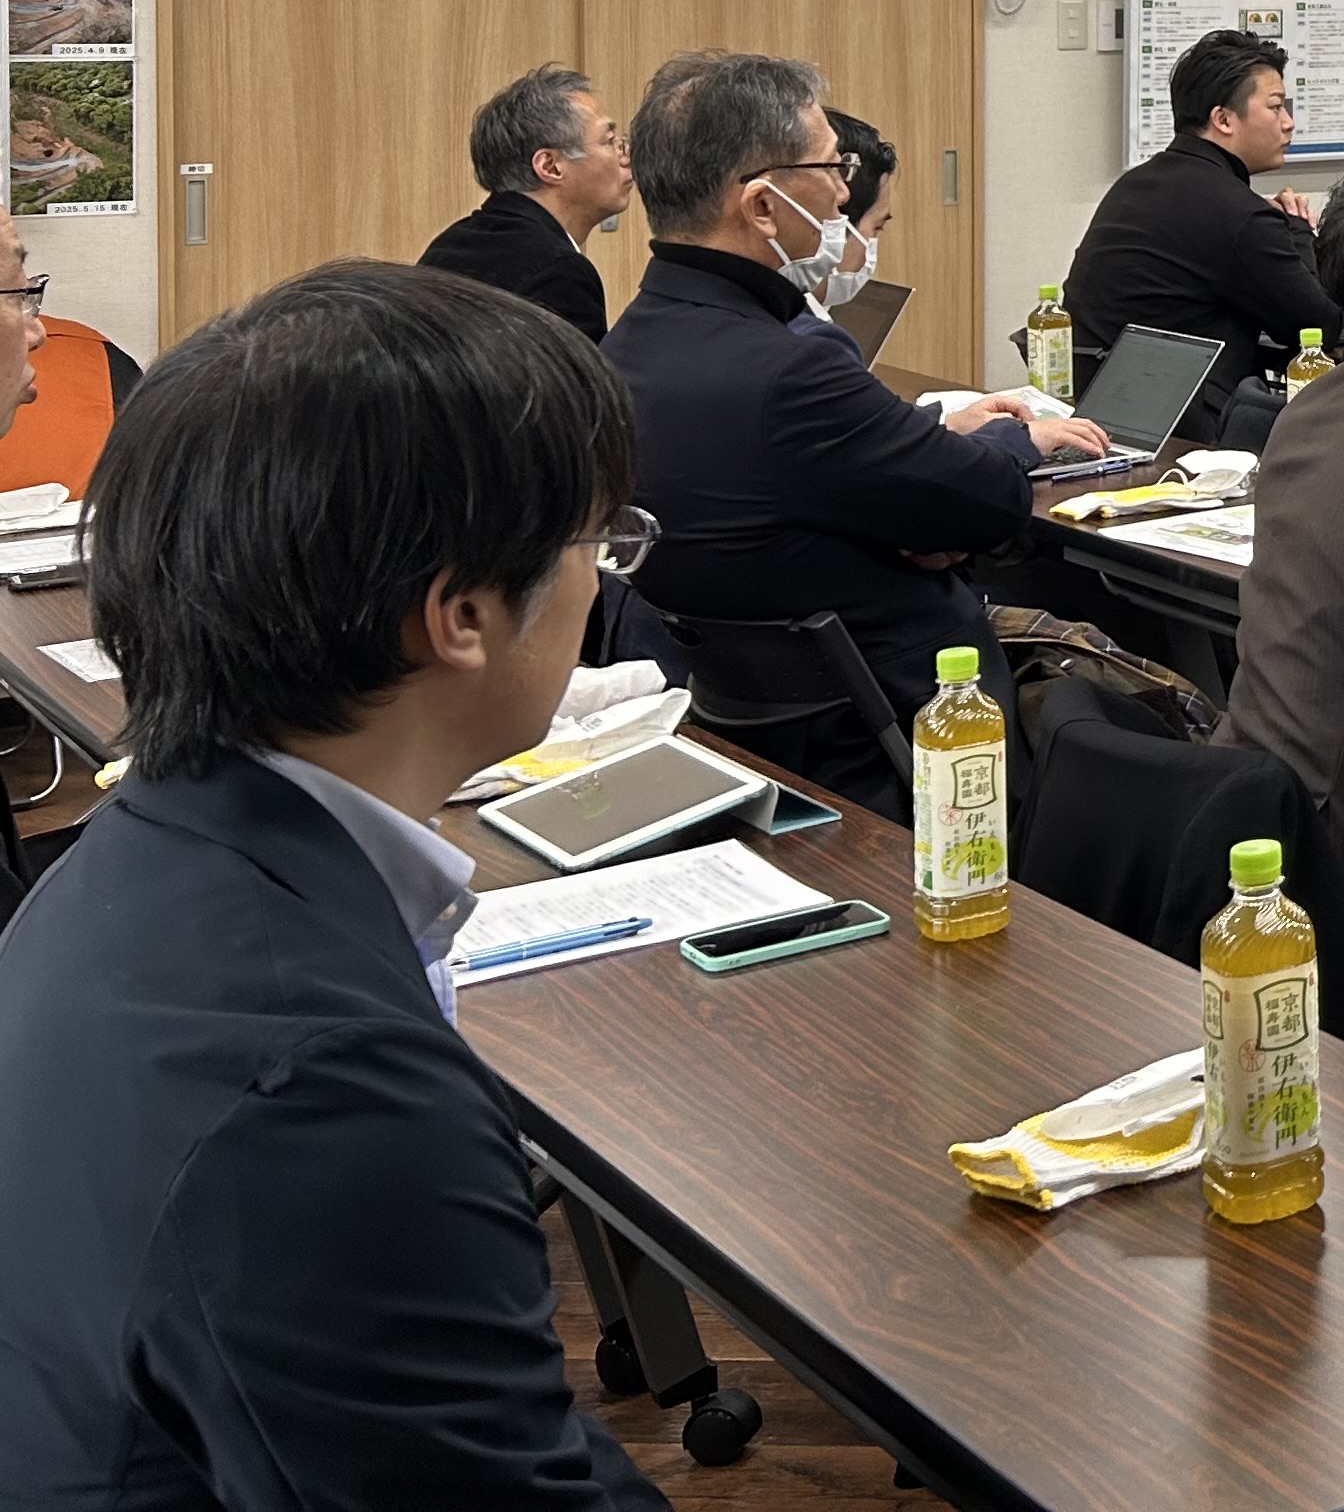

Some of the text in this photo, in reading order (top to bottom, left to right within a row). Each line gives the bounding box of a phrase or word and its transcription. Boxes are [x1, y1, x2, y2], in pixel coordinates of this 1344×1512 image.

[59, 46, 105, 55] 2025.4.9
[54, 204, 106, 214] 2025.5.15
[973, 765, 991, 796] 京都
[965, 811, 987, 887] 伊右衛門
[1280, 992, 1302, 1034] 京都
[1271, 1052, 1299, 1151] 伊右衛門
